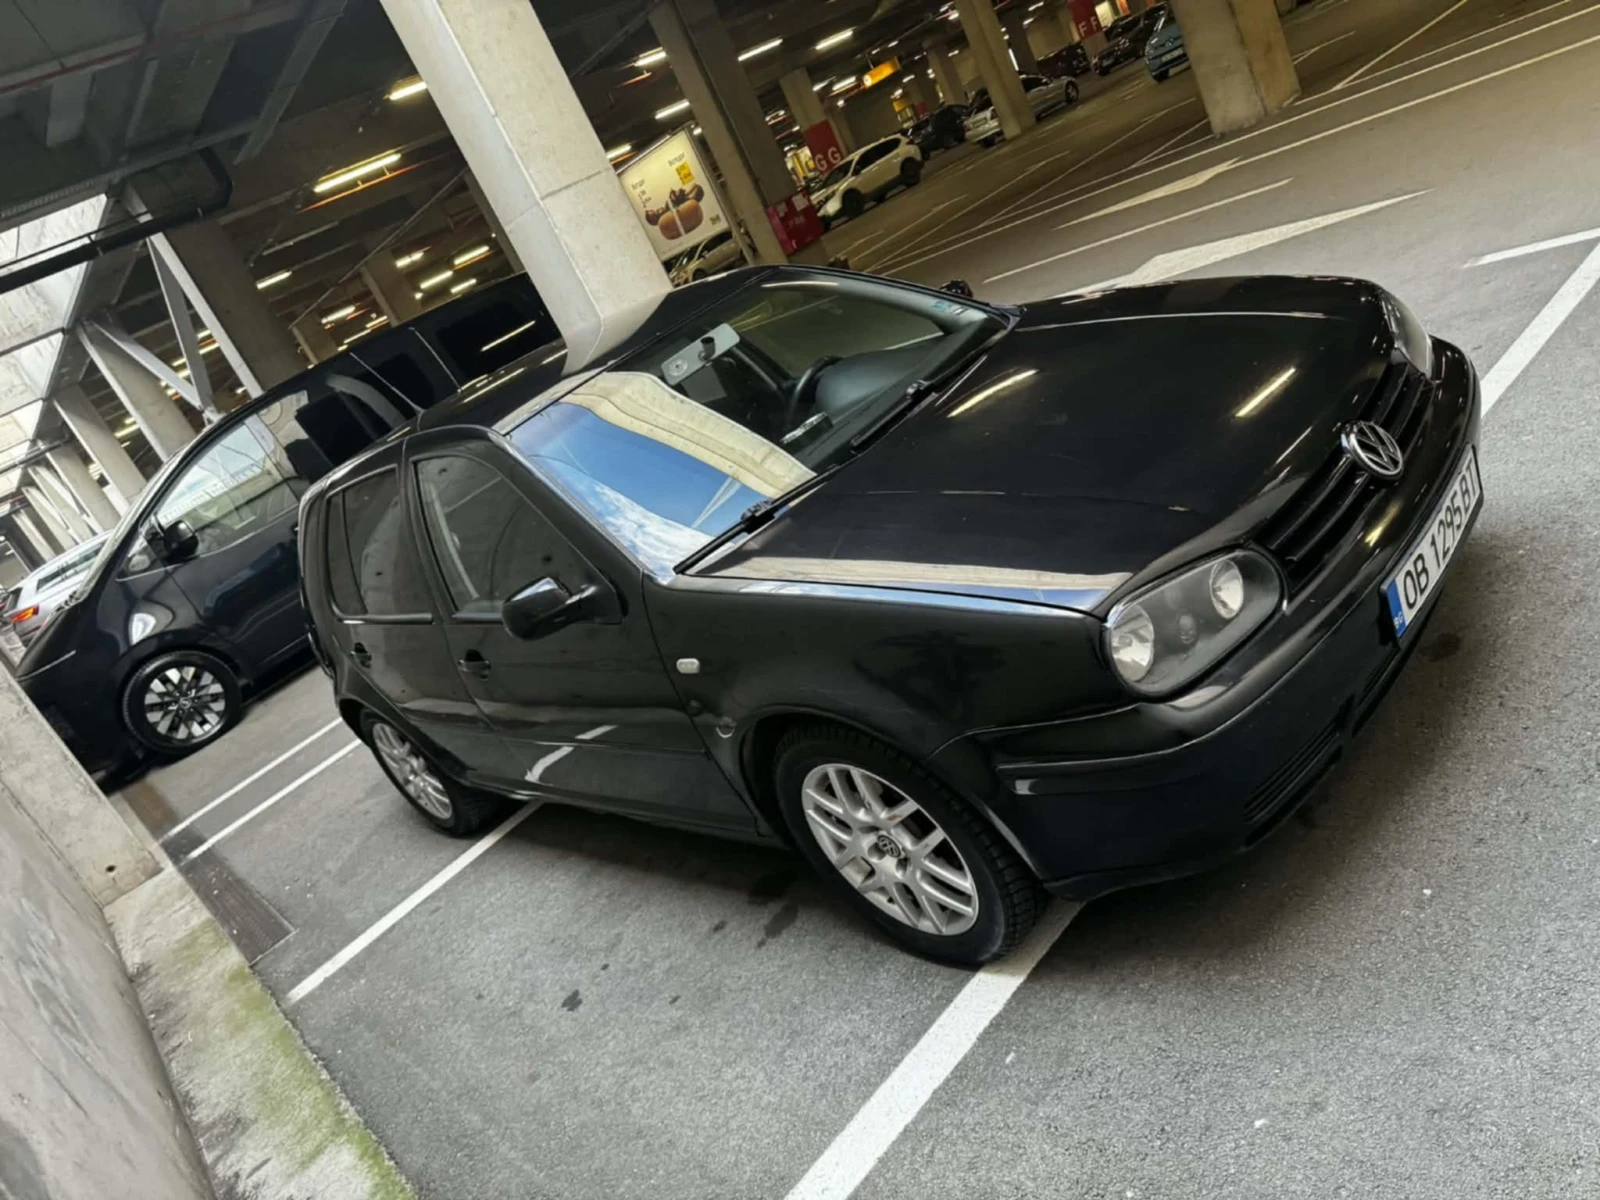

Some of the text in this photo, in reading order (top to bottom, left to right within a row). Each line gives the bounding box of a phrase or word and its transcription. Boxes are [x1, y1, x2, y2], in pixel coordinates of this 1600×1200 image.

[1078, 21, 1087, 37] F
[815, 146, 841, 171] G G
